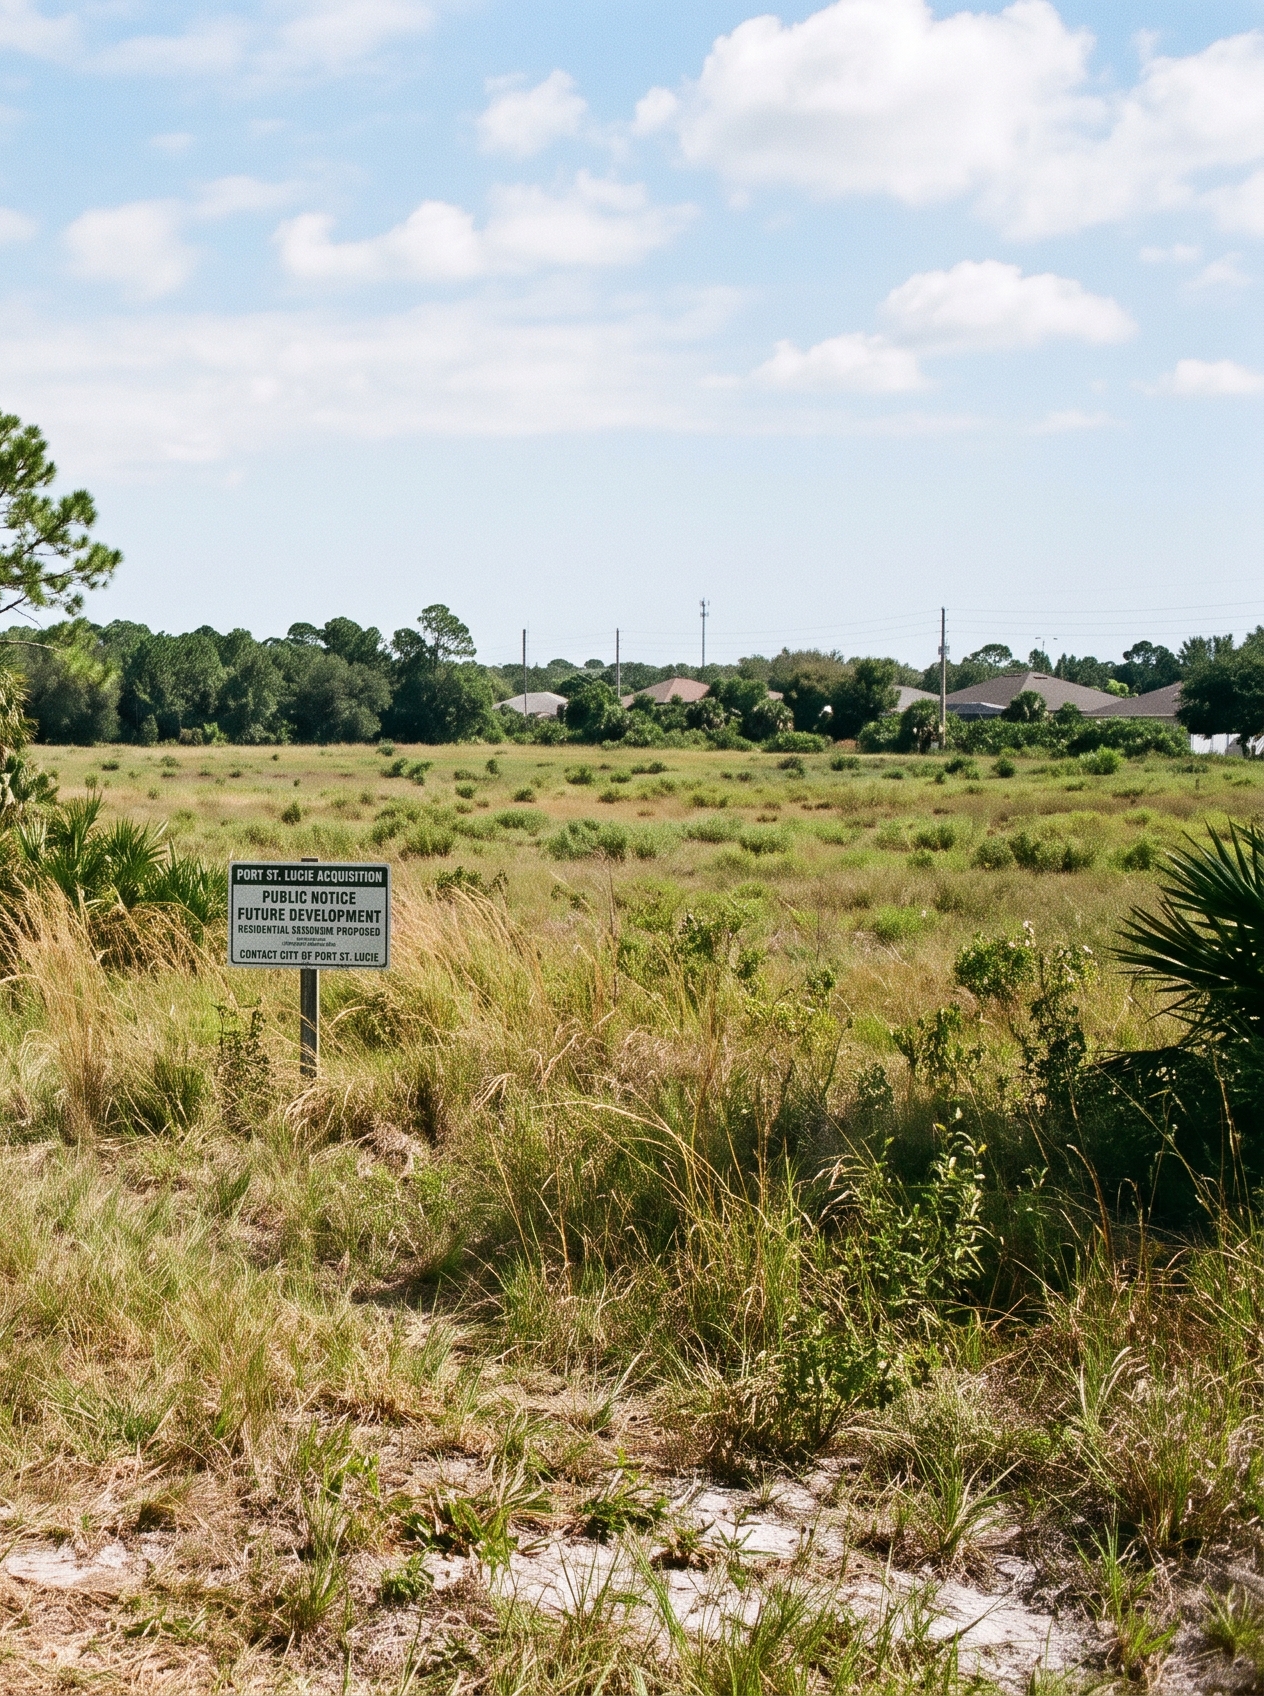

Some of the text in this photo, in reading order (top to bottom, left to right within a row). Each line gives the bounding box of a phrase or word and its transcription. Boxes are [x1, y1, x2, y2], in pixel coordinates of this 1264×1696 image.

[237, 869, 382, 883] PORT ST. LUCIE ACQUISITION
[262, 890, 356, 905] PUBLIC NOTICE
[238, 907, 381, 923] FUTURE DEVELOPMENT
[238, 925, 289, 935] RESIDENTIAL
[239, 949, 277, 960] CONTACT
[314, 951, 337, 961] PORT
[339, 952, 352, 962] ST.
[354, 952, 379, 963] LUCIE
